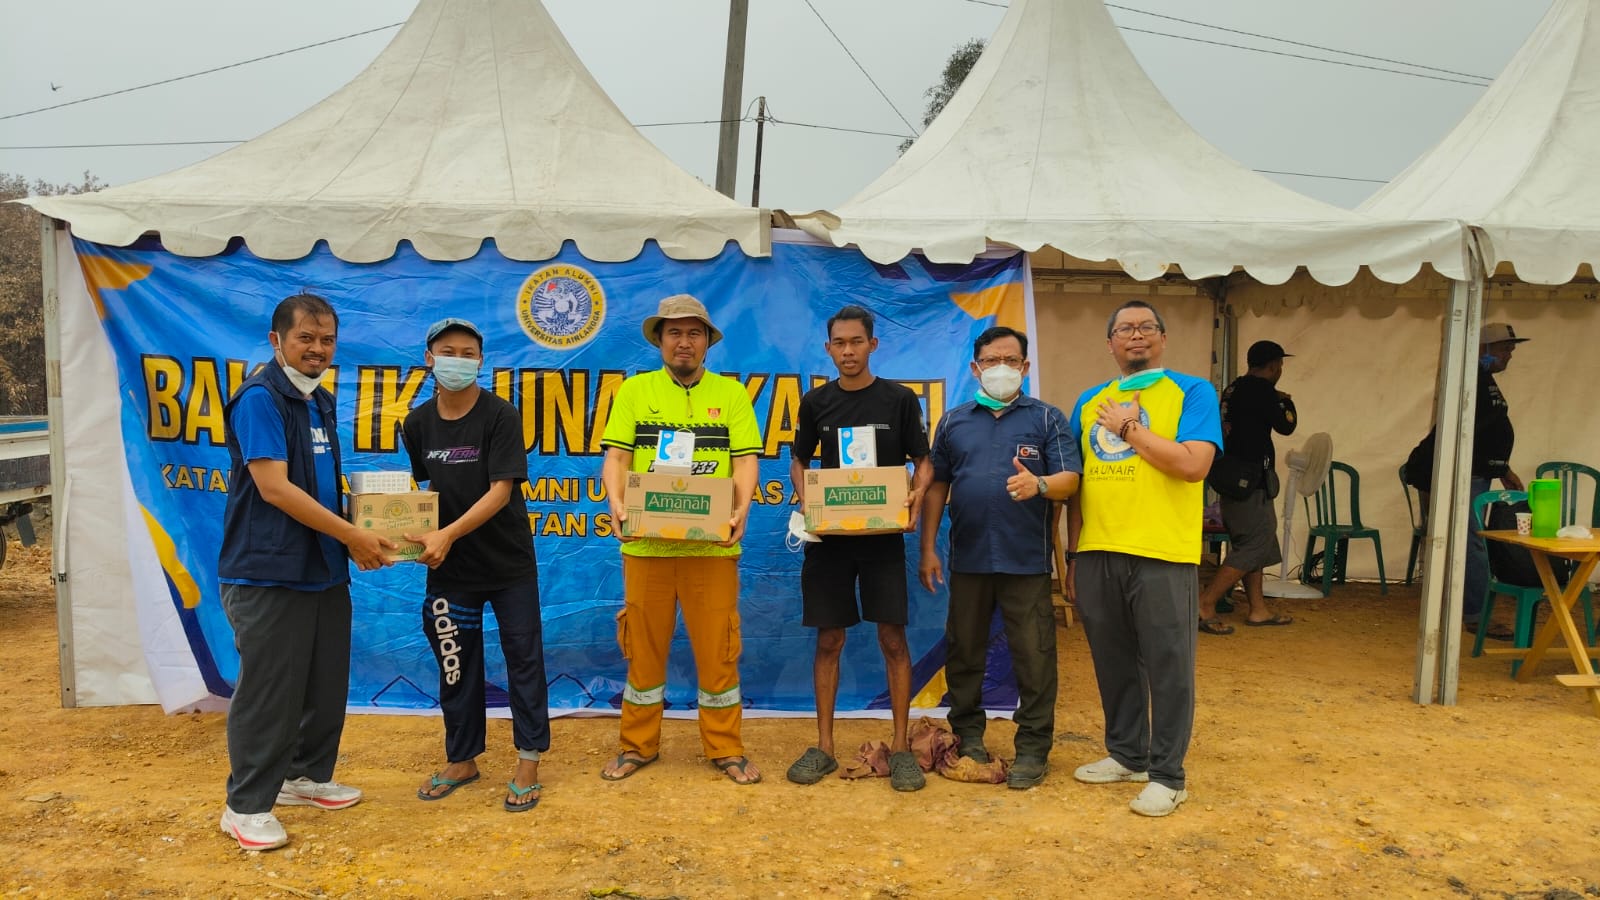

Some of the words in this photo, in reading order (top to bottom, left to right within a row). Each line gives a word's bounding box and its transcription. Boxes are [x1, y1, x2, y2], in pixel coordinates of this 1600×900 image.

[525, 269, 559, 295] IKATAN
[564, 268, 599, 296] ALUMNI
[521, 309, 563, 345] UNIVERSITAS
[648, 494, 710, 512] Amanah
[826, 487, 886, 502] Amanah
[432, 597, 462, 686] adidas
